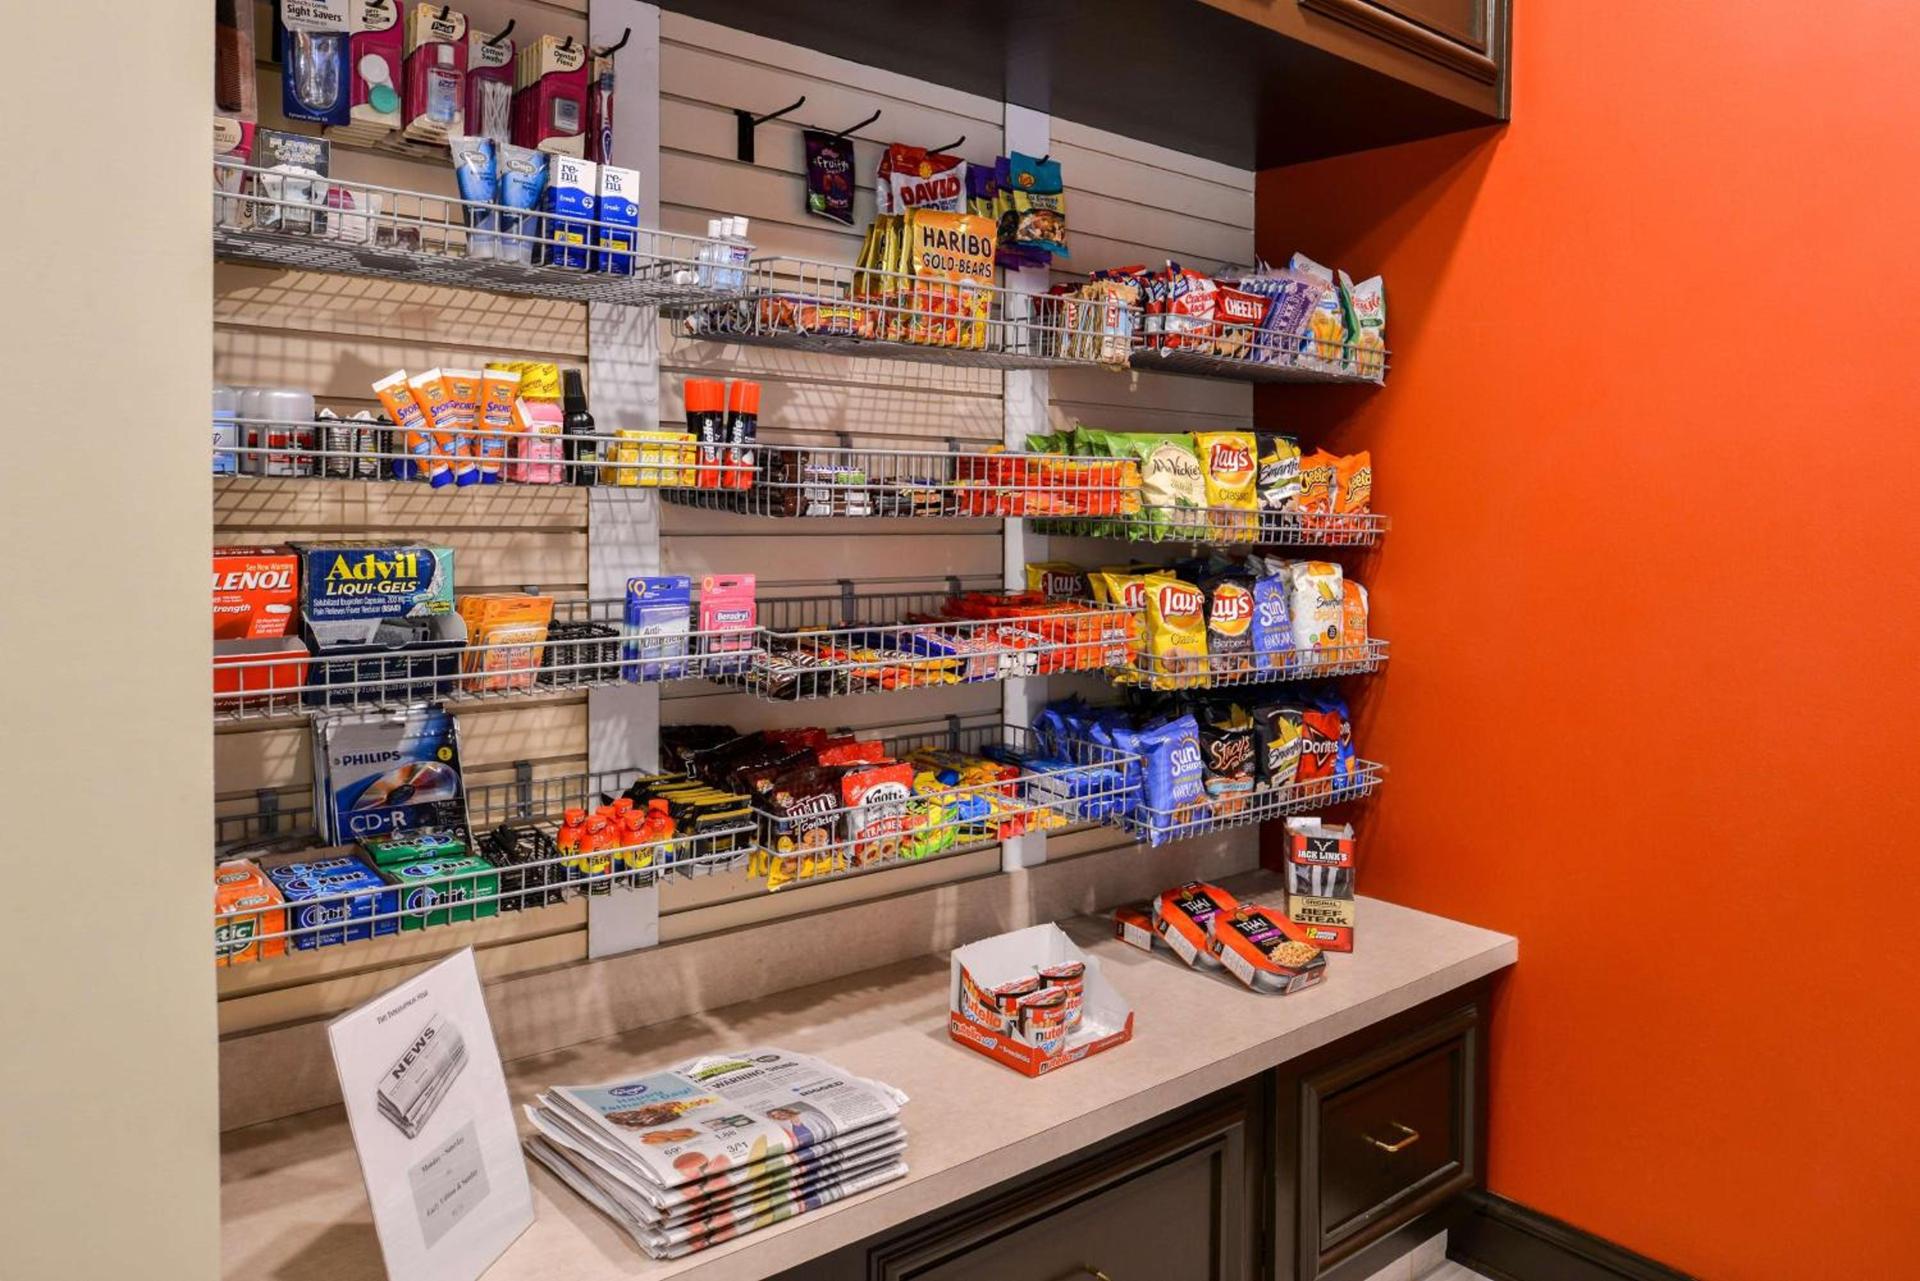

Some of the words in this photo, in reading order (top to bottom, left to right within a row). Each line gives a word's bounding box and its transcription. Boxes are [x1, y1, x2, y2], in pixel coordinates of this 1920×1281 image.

[287, 4, 311, 18] Sight
[313, 9, 342, 22] Savers
[480, 46, 504, 58] Cotton
[561, 173, 577, 183] nu
[605, 182, 621, 192] nu
[901, 175, 961, 206] DAVID
[922, 226, 993, 258] HARIBO
[922, 252, 993, 278] GOLD-BEARS
[1213, 443, 1249, 472] Lay's
[324, 552, 418, 581] Advil
[213, 570, 291, 591] LENOL
[213, 603, 252, 614] trength
[716, 611, 749, 621] Benadryl
[1302, 739, 1340, 754] Doritos
[342, 750, 402, 766] PHILIPS
[1170, 746, 1201, 776] Sun
[350, 811, 407, 833] CD-R
[1298, 850, 1318, 859] JACK
[1295, 913, 1347, 925] STEAK
[1301, 906, 1342, 916] BEEF
[391, 1026, 436, 1080] NEWS
